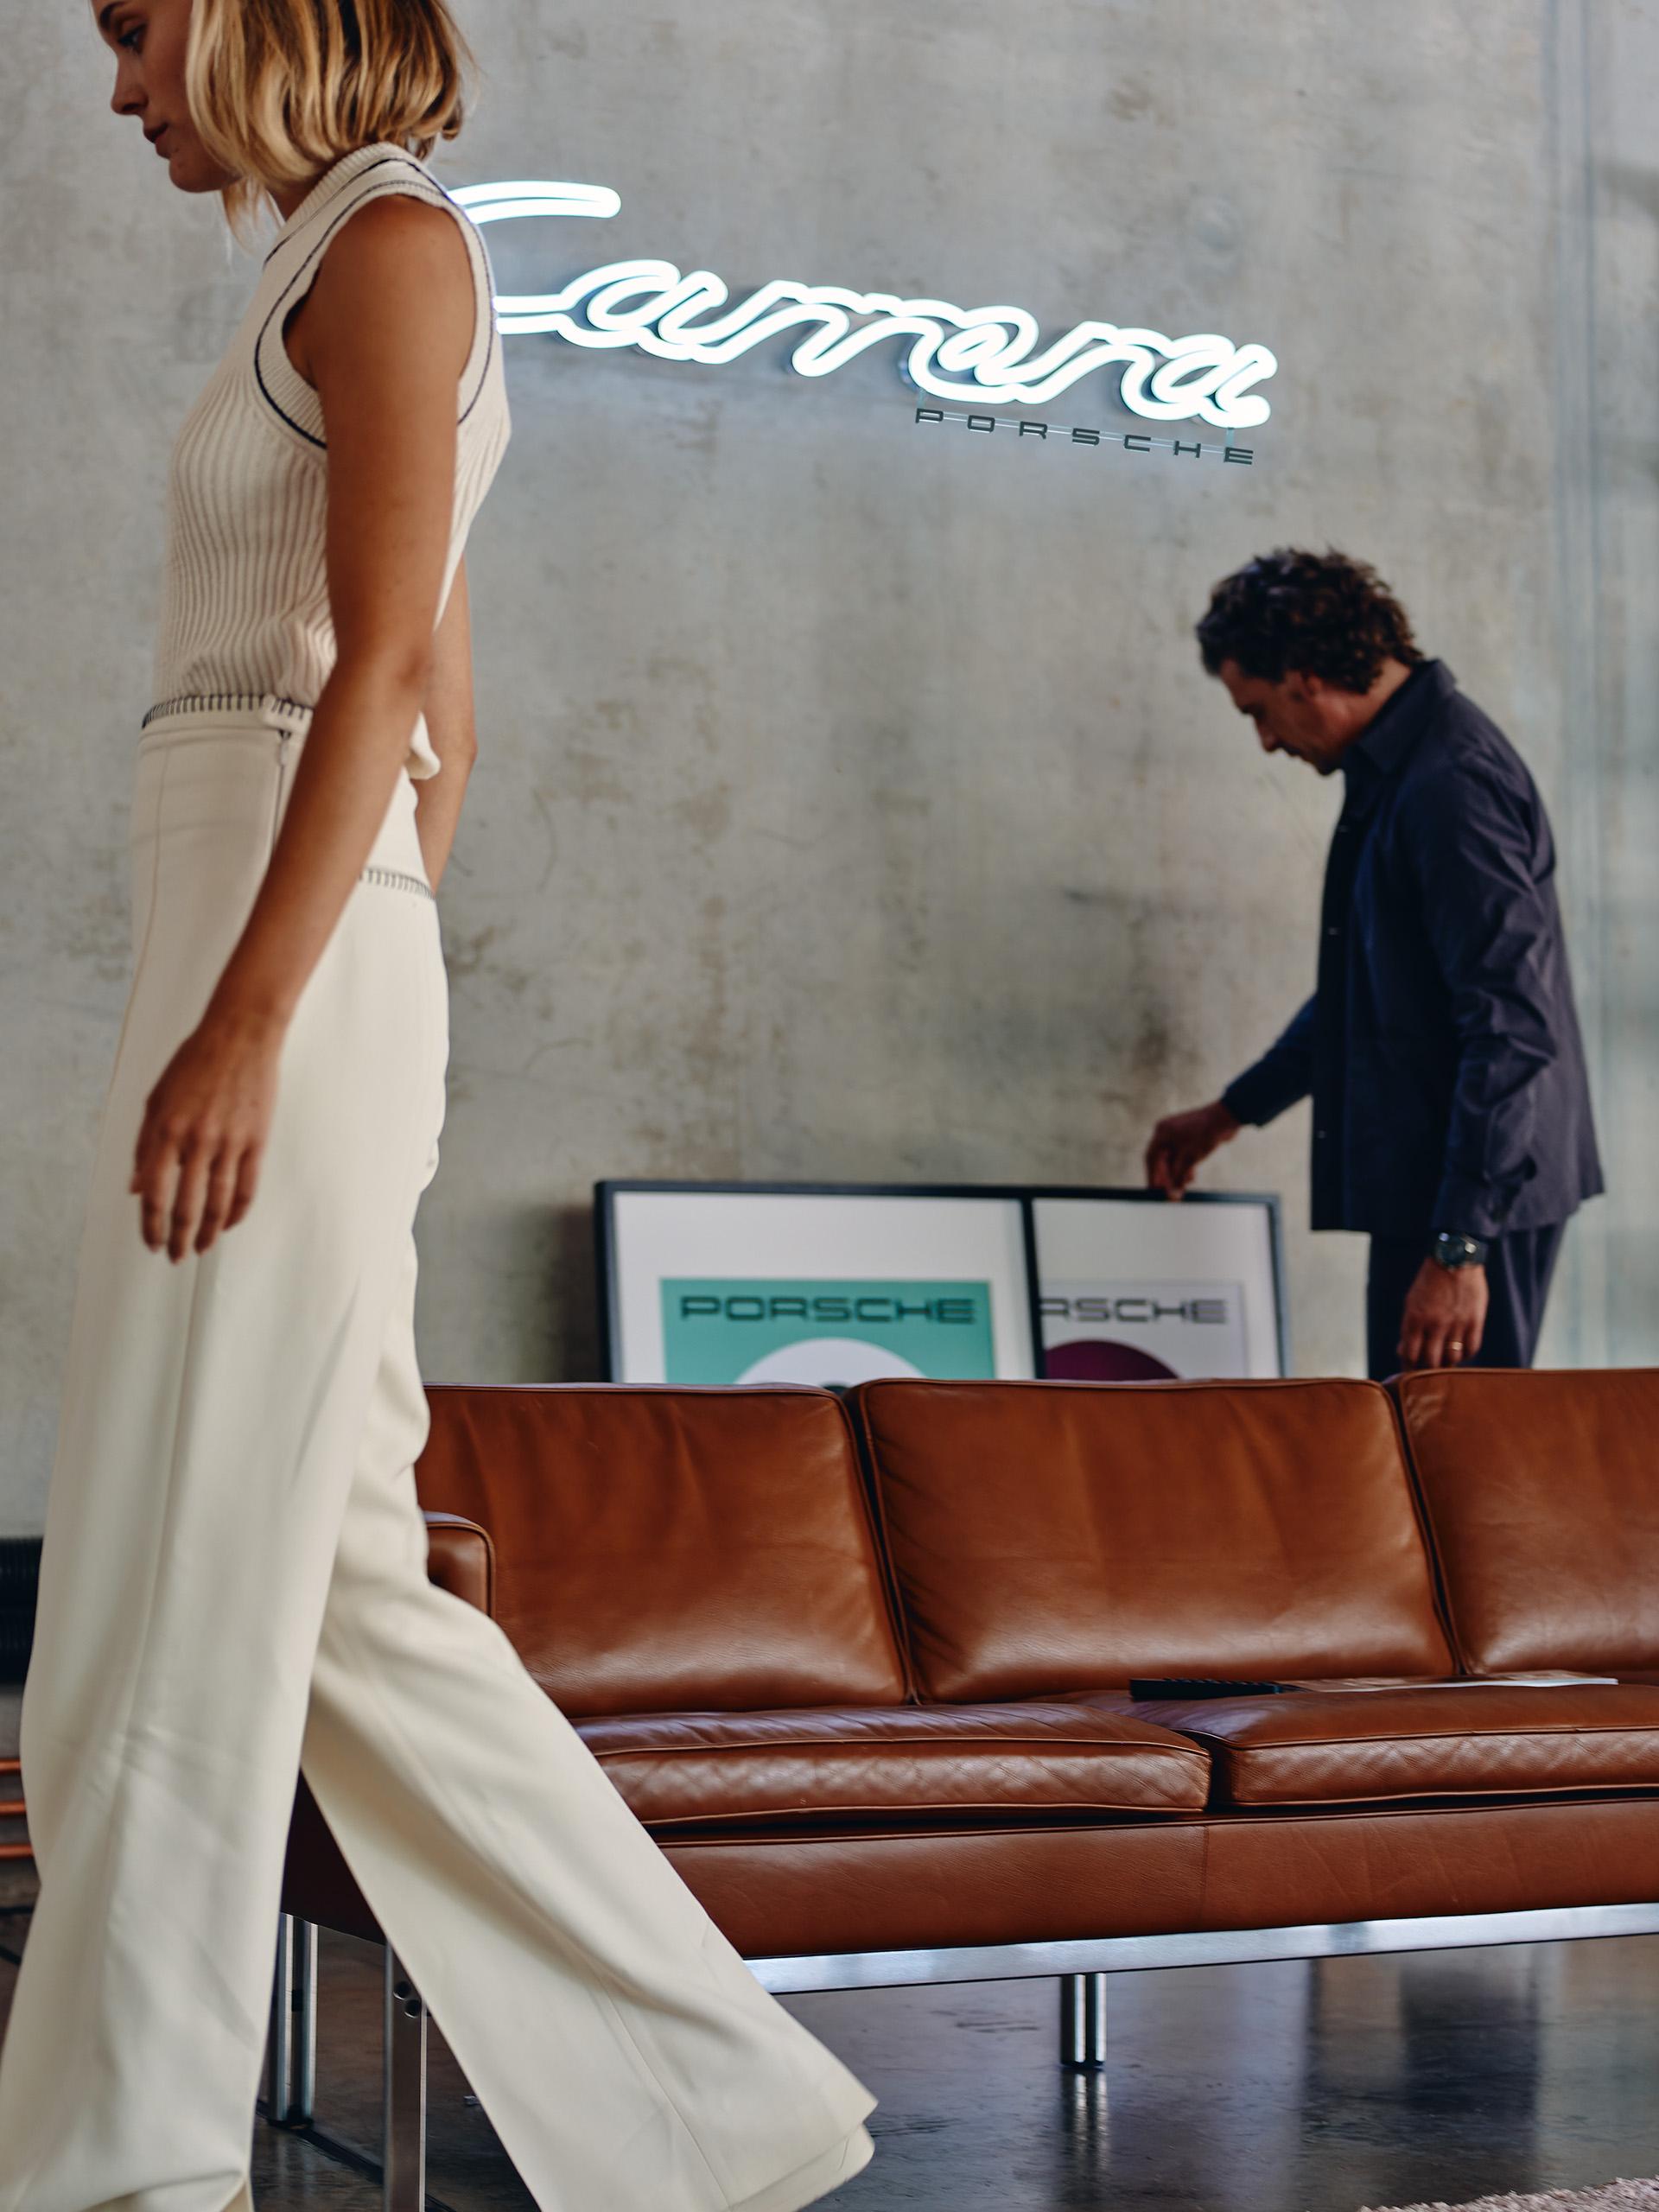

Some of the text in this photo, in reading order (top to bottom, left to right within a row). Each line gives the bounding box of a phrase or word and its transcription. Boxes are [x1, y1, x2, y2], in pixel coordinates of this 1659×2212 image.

[915, 408, 1254, 465] PORSCHE
[681, 1296, 976, 1324] PORSCHE
[1039, 1298, 1226, 1323] RSCHE
